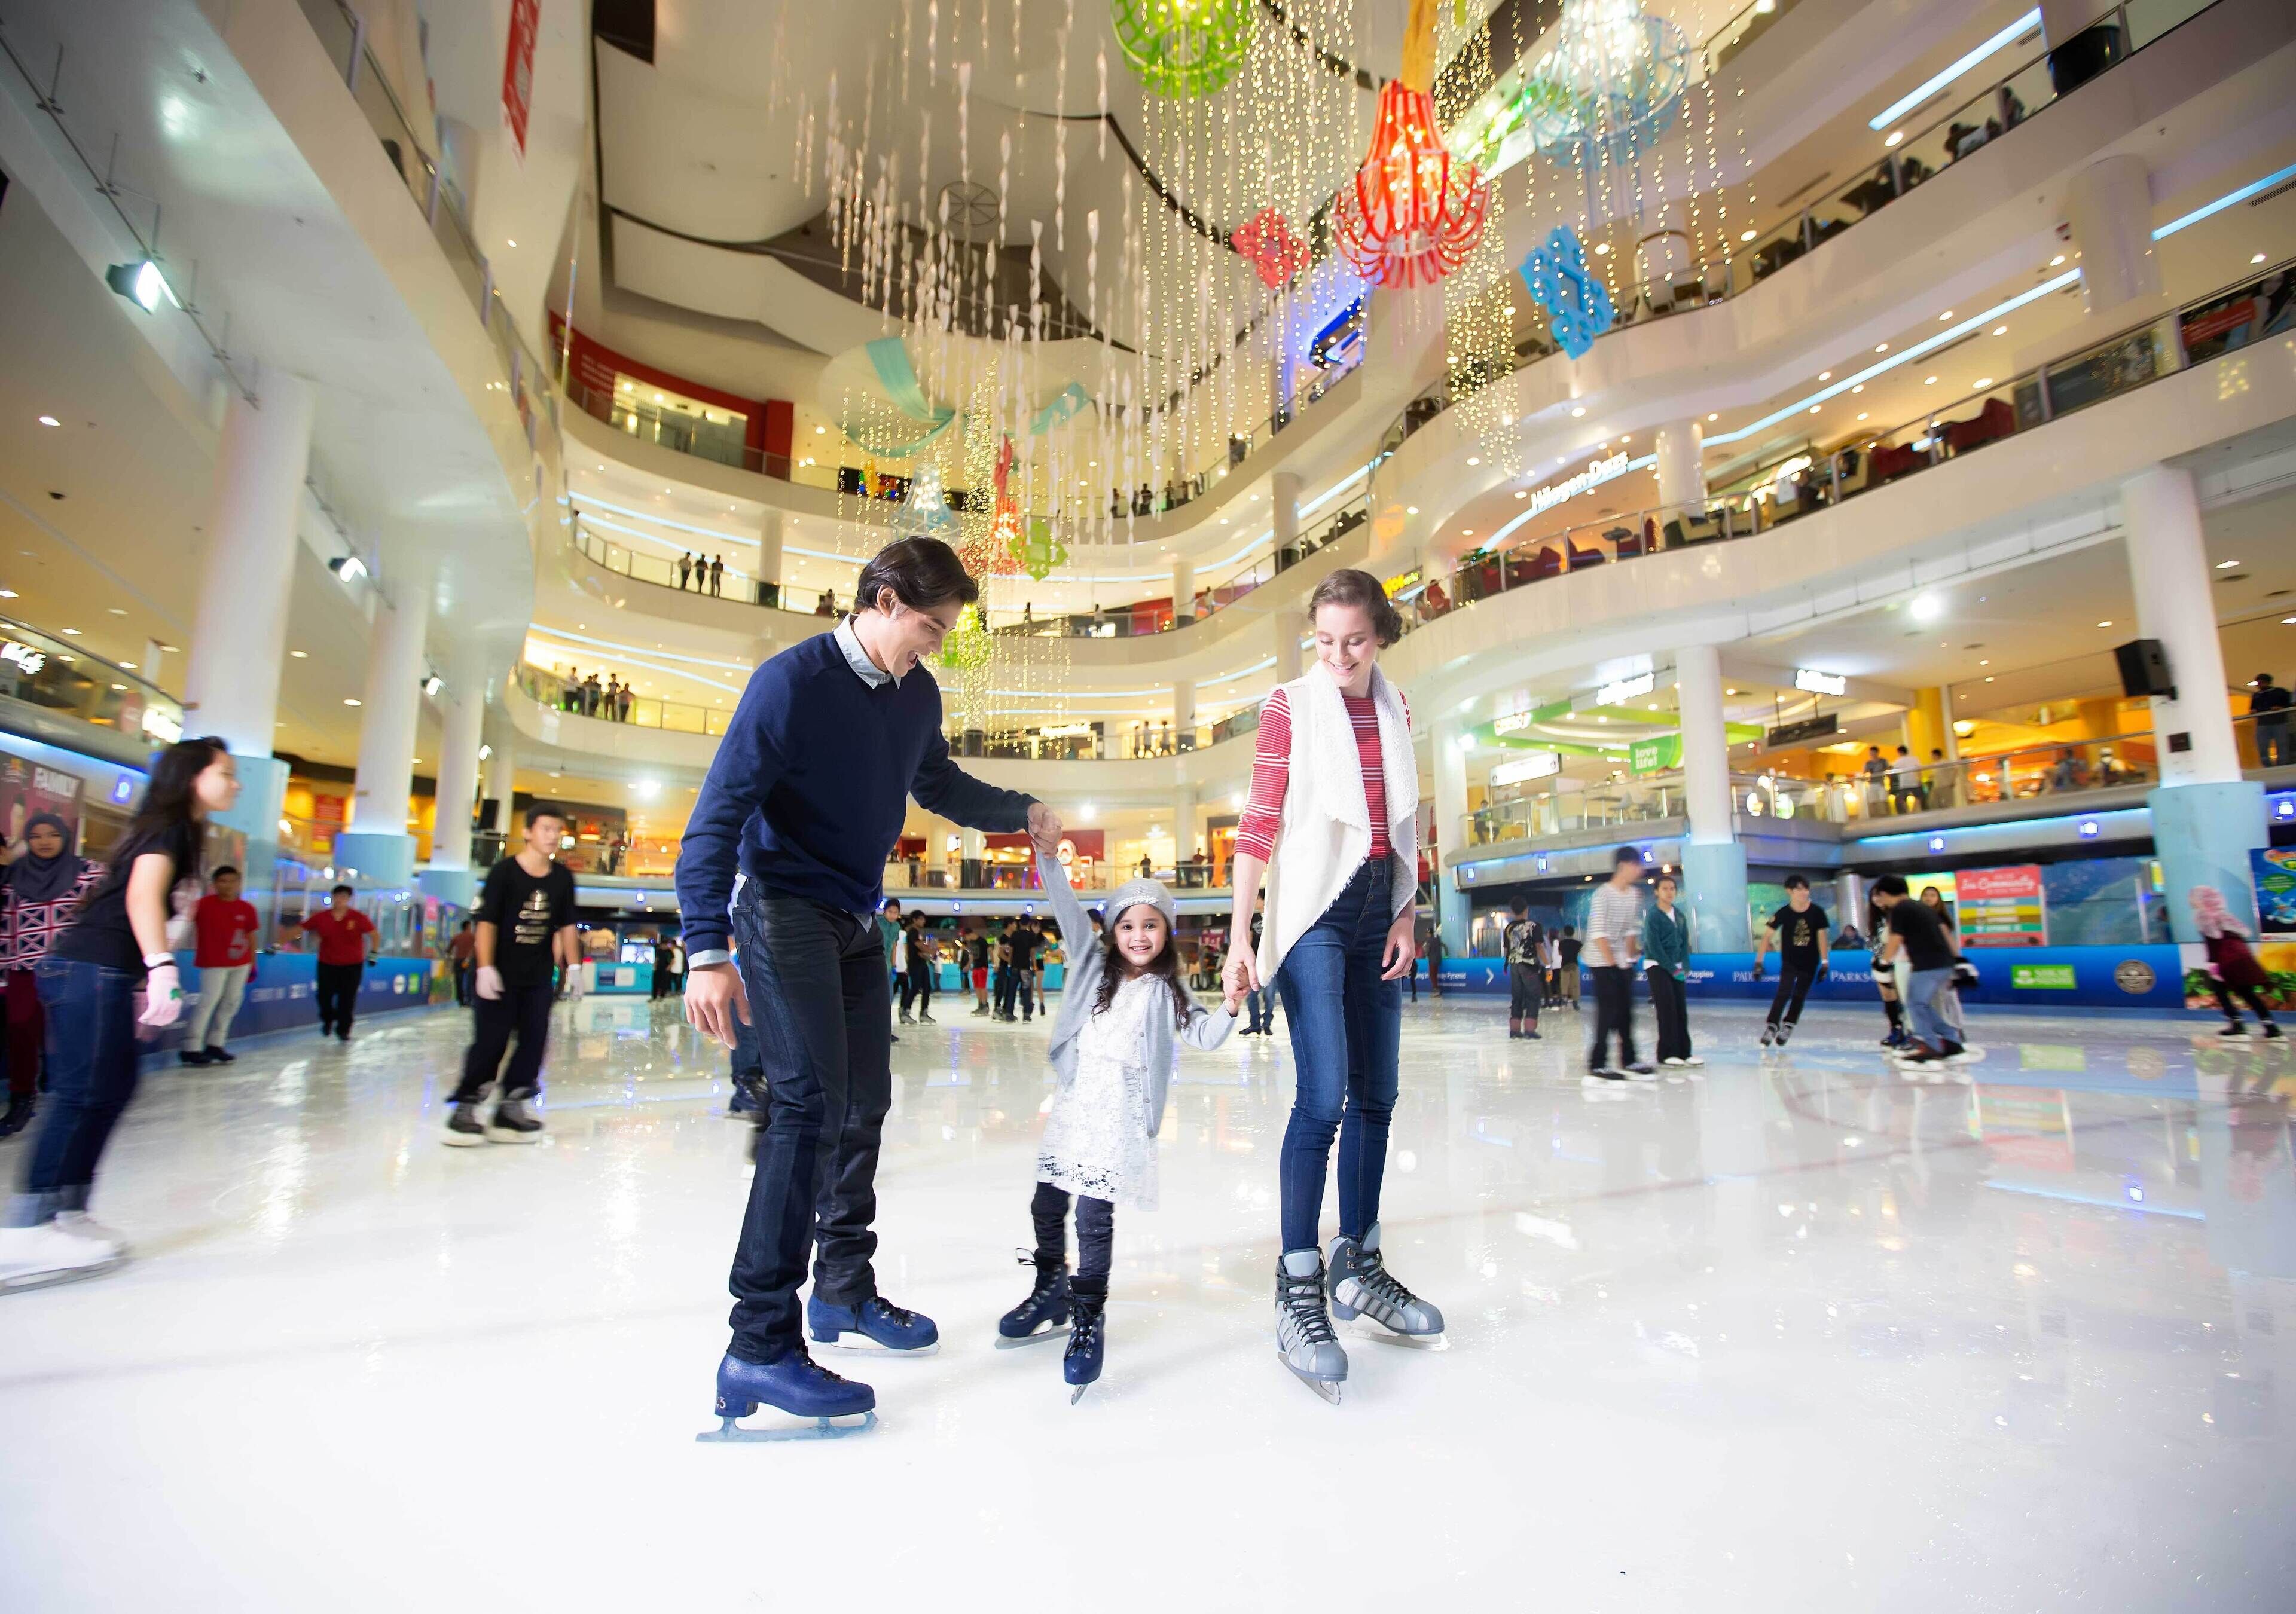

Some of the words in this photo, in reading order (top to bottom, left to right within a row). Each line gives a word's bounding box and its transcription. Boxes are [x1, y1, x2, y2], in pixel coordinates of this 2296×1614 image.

[1635, 746, 1657, 759] love
[1635, 757, 1657, 770] life!
[33, 766, 81, 798] FAMILY
[1831, 970, 1873, 982] PARKS
